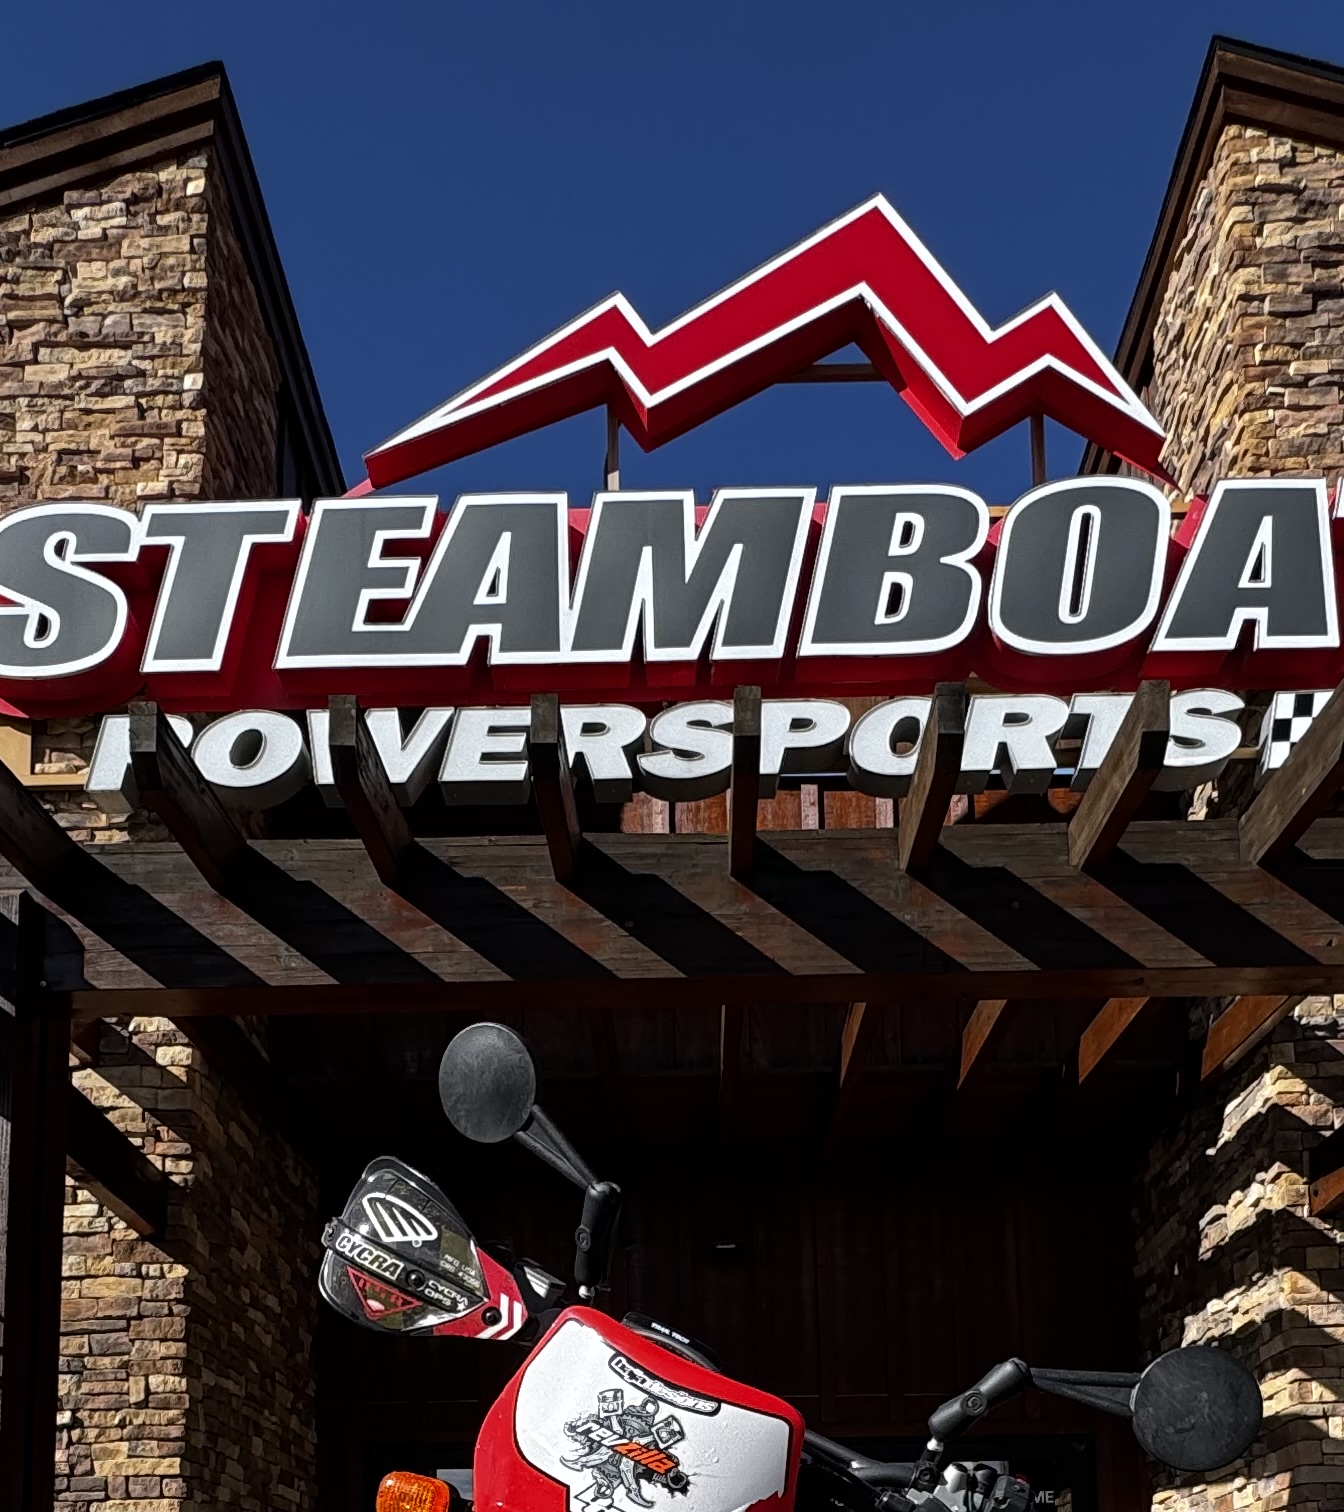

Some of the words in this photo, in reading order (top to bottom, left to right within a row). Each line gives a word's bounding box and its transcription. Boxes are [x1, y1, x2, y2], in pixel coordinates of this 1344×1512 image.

[336, 1232, 404, 1280] CYCRA
[424, 1288, 452, 1307] OPS
[428, 1279, 468, 1306] CYCRA
